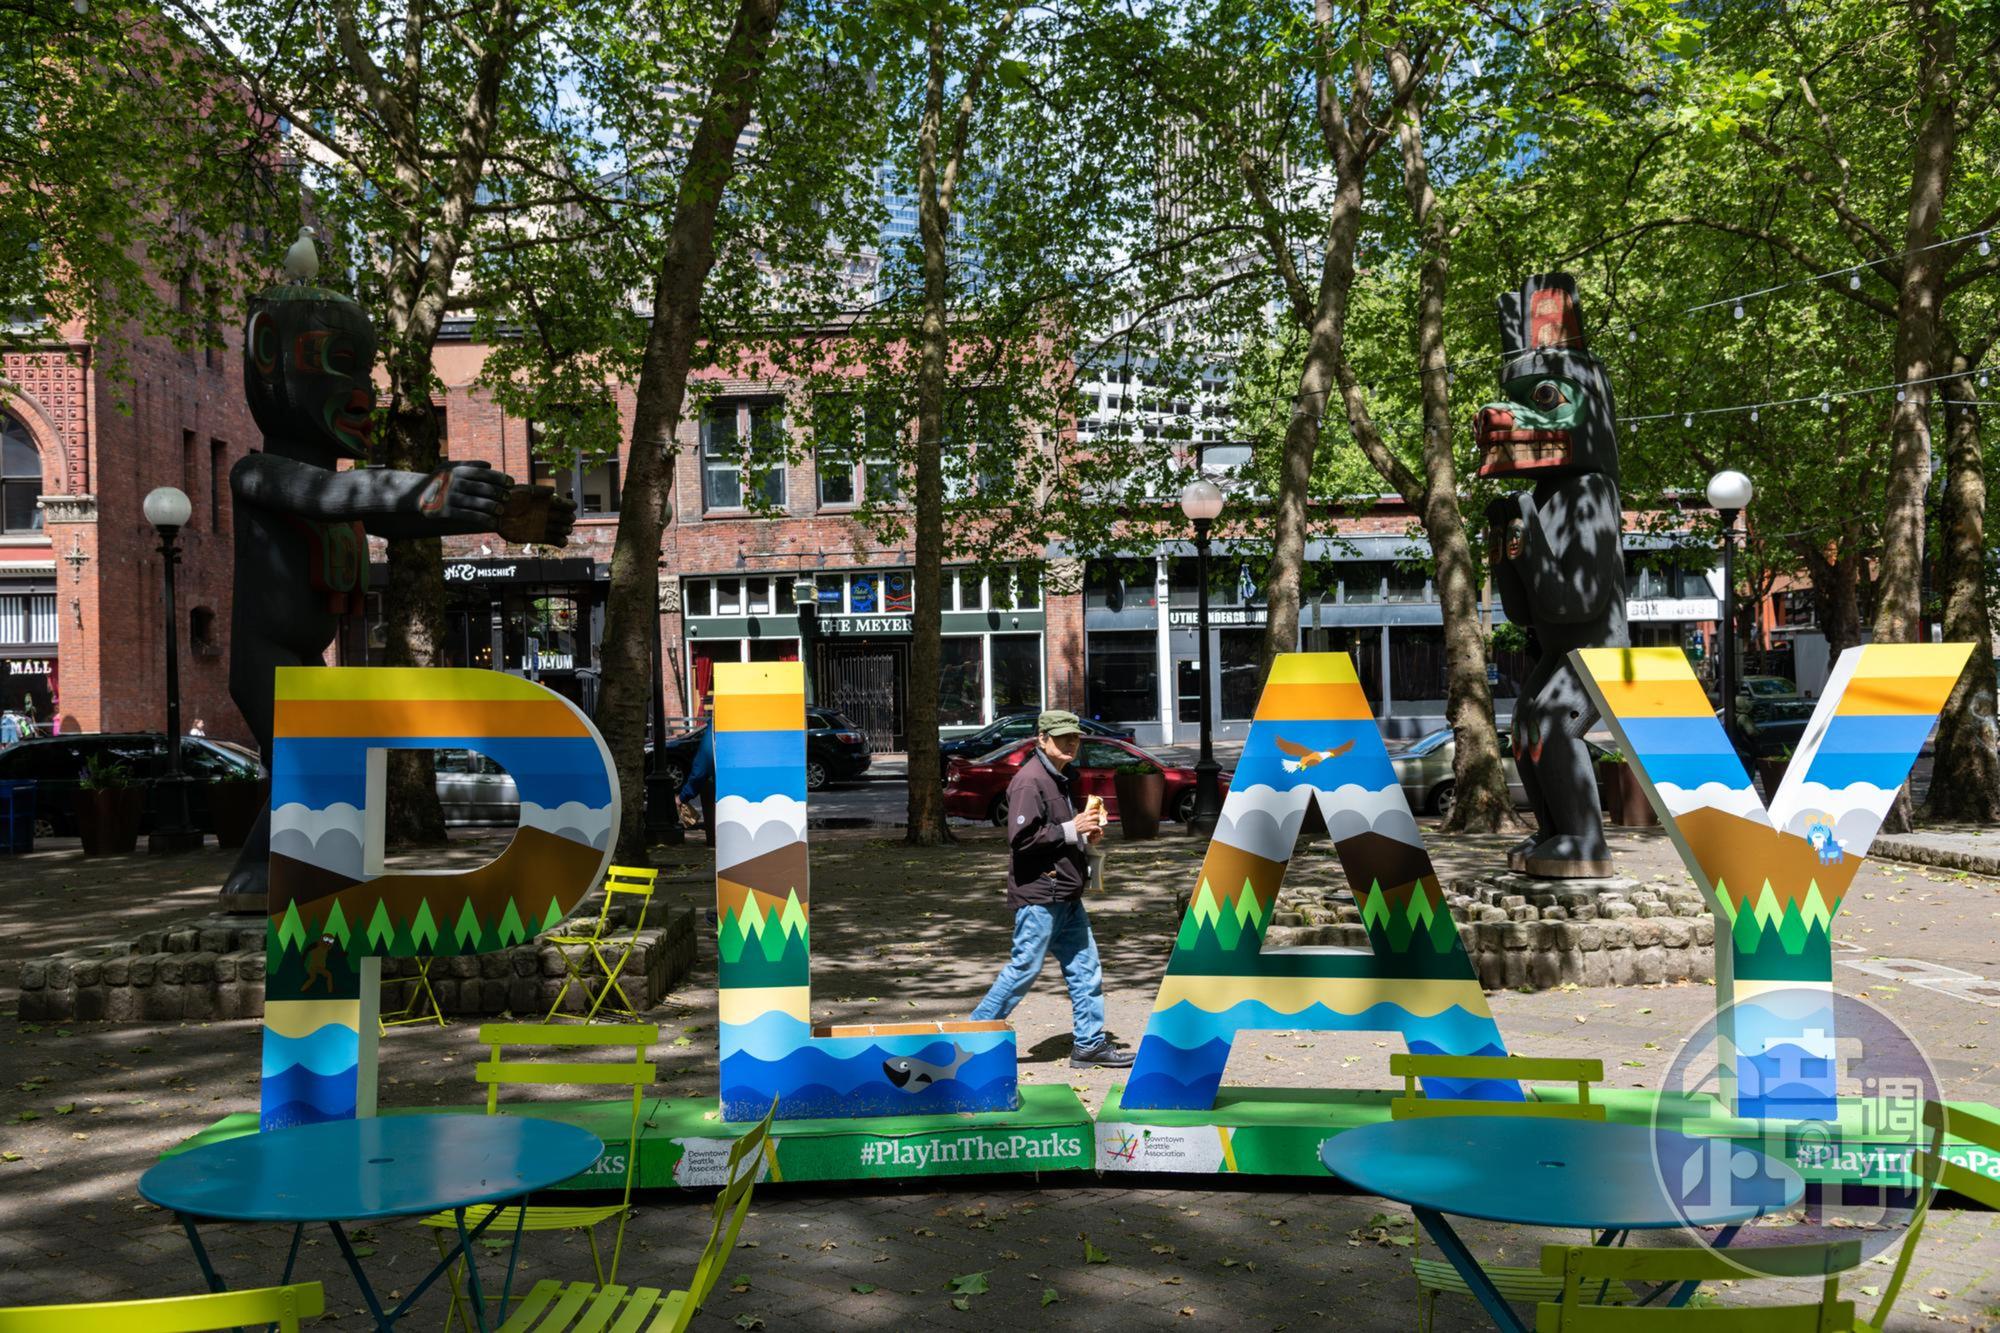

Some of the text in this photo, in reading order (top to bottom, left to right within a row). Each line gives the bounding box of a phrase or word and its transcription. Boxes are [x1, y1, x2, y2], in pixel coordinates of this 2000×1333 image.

[477, 565, 517, 577] MISCHIEF
[818, 618, 914, 633] THE MEYER
[10, 659, 52, 675] MALL
[260, 642, 1976, 1132] PLAY
[688, 1150, 729, 1158] Downtown
[860, 1132, 1081, 1169] #PlayInTheParks
[1144, 1149, 1186, 1157] Association
[688, 1157, 715, 1165] Seattle
